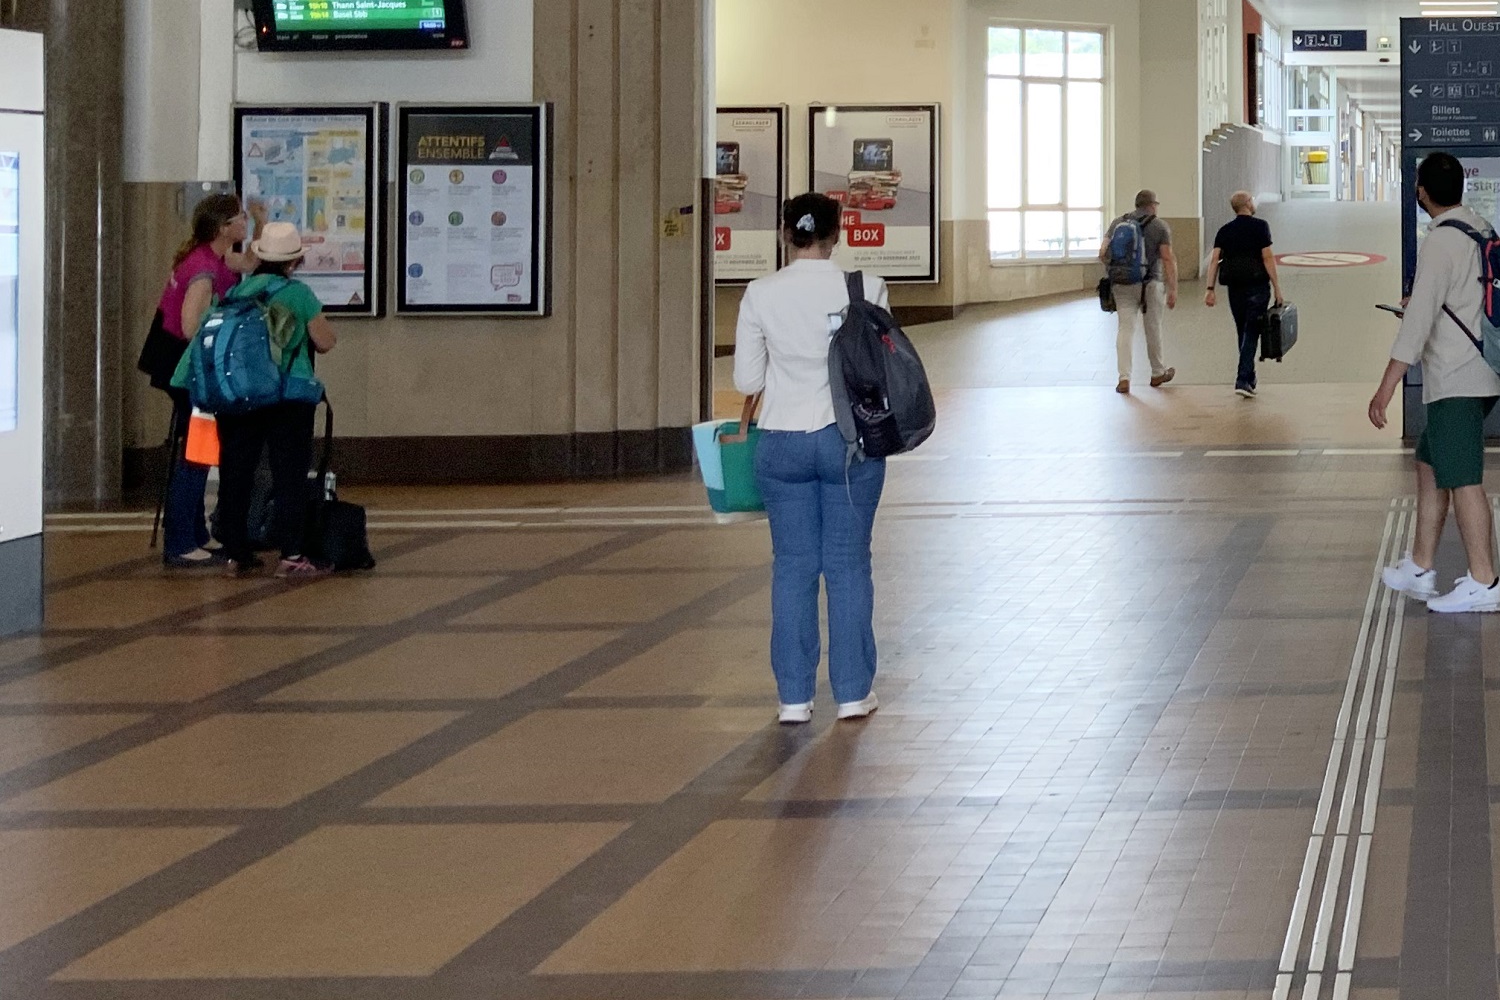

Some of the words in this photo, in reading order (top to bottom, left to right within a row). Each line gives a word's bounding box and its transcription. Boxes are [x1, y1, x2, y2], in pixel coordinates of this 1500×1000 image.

[1429, 19, 1458, 32] HALL
[1462, 19, 1500, 32] OUEST
[1432, 105, 1460, 115] Billets
[1431, 127, 1470, 137] Toilettes
[418, 135, 485, 147] ATTENTIFS
[418, 148, 485, 159] ENSEMBLE
[842, 215, 855, 225] HE
[853, 229, 879, 241] BOX
